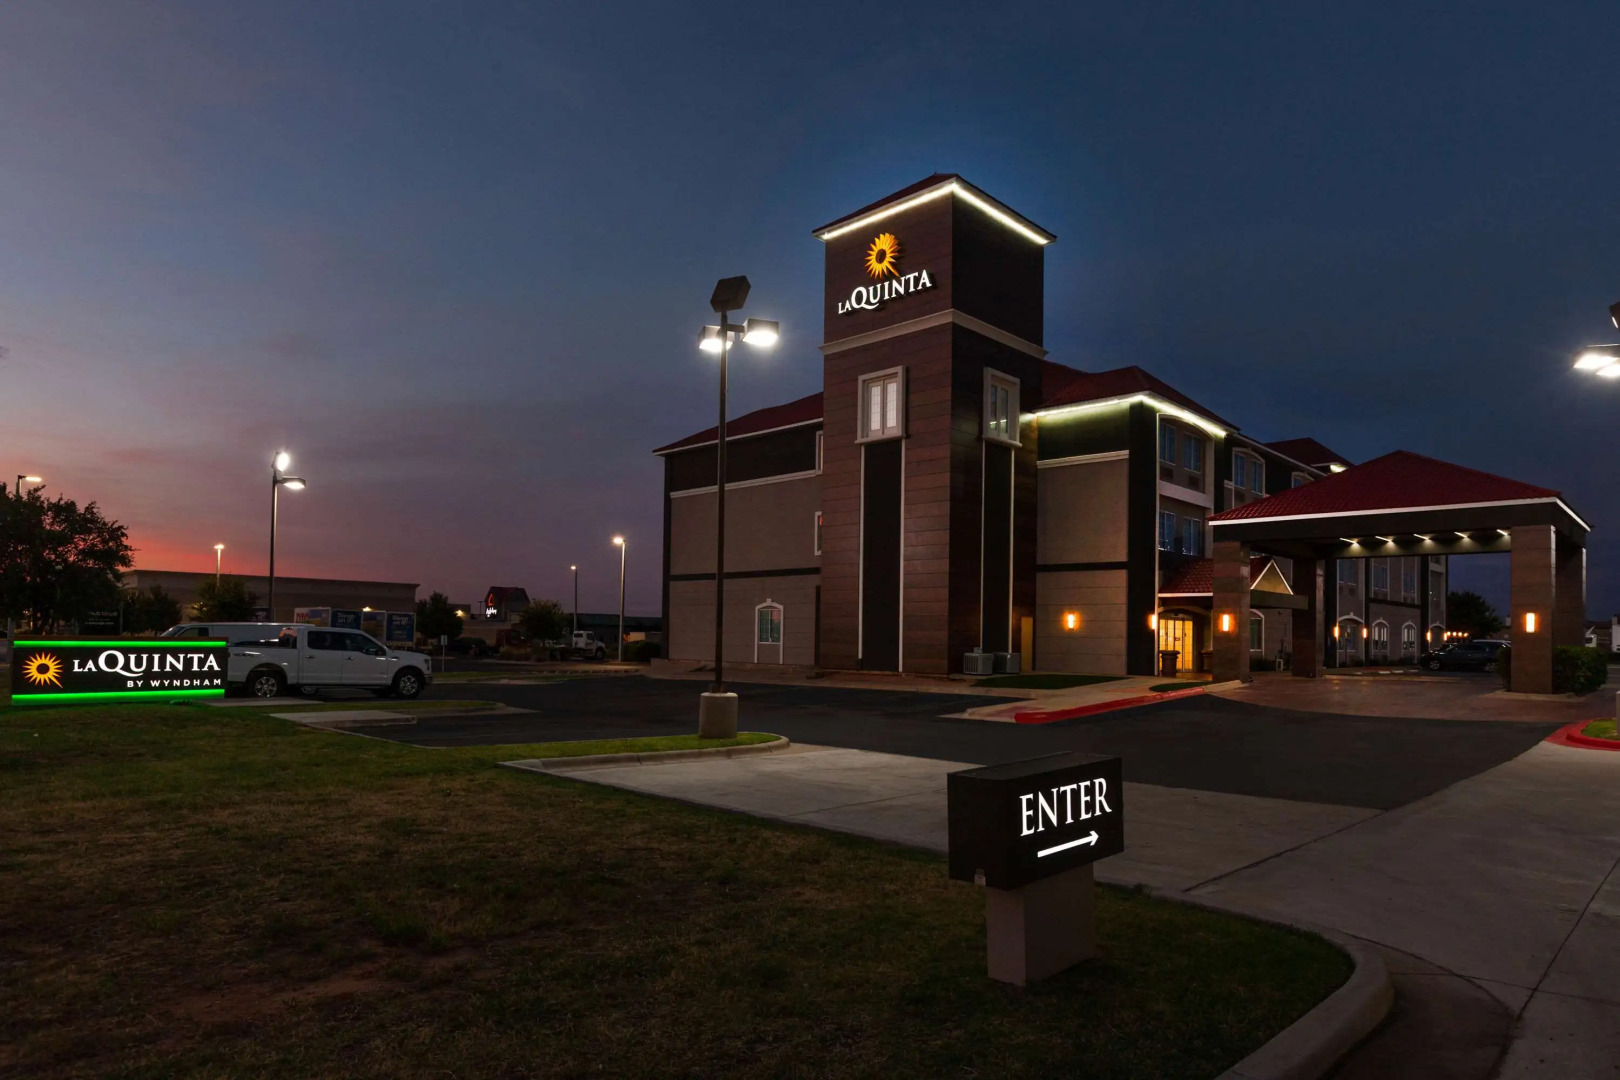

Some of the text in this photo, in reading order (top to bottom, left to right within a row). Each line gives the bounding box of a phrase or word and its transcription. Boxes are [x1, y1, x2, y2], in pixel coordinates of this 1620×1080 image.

[838, 269, 932, 314] LA QUINTA
[72, 650, 221, 677] LA QUINTA
[127, 679, 222, 688] BY WYNDHAM
[1019, 777, 1112, 837] ENTER
